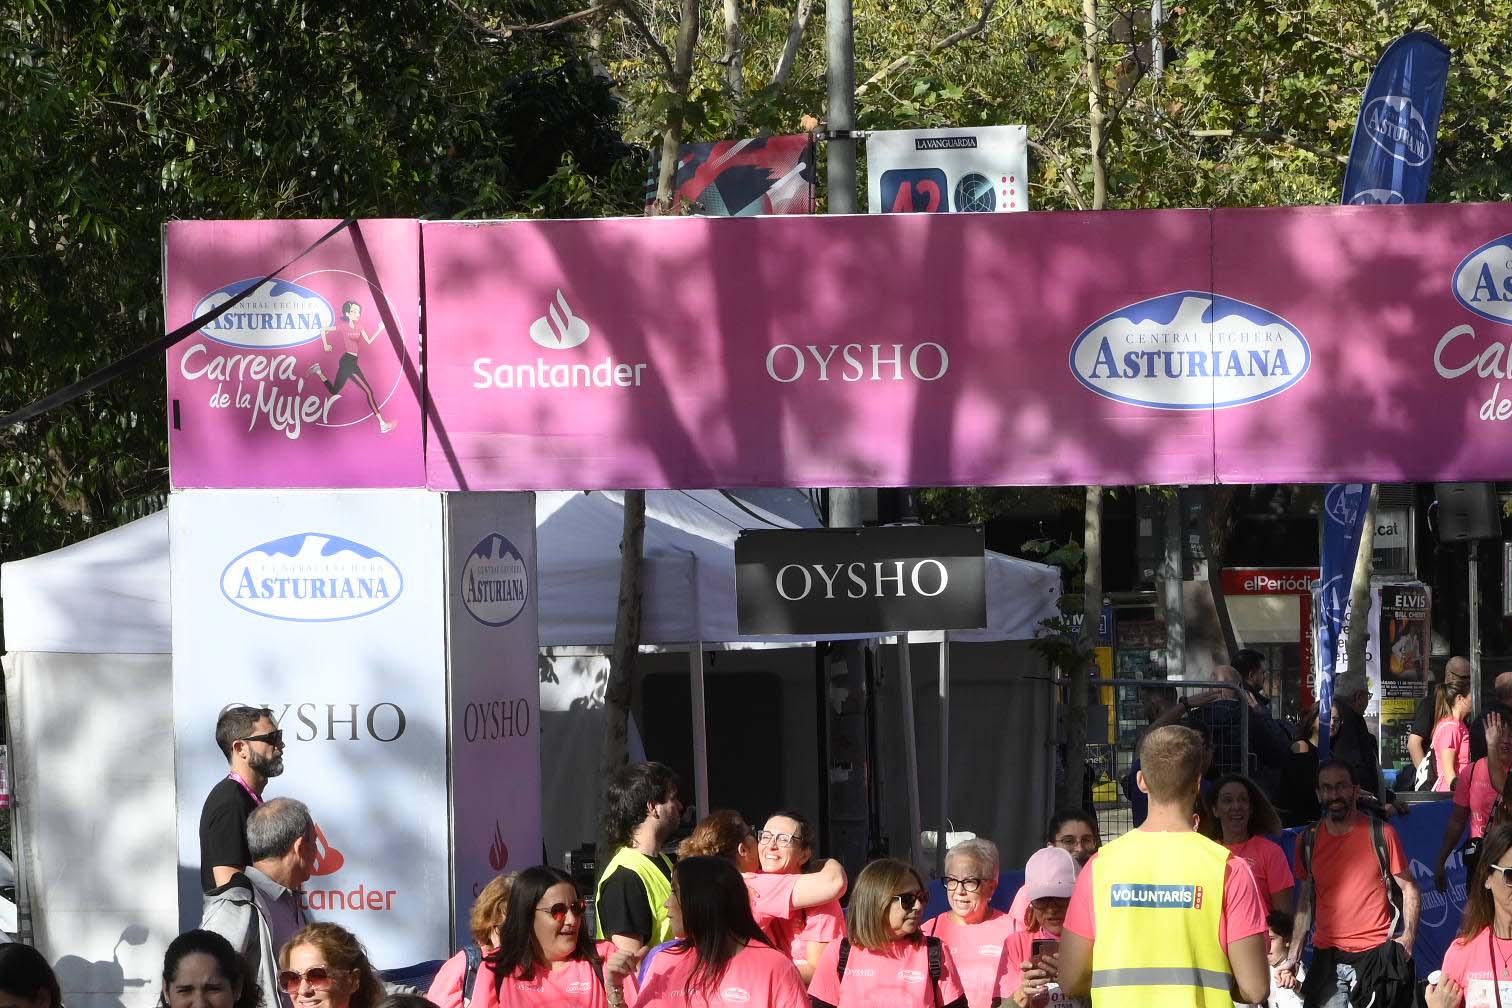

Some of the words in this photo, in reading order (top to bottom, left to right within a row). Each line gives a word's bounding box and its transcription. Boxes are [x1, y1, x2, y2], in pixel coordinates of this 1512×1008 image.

[204, 304, 323, 330] ASTURIANA
[1125, 332, 1198, 344] CENTRAL
[180, 344, 298, 382] Carrera
[473, 357, 647, 389] Santander
[766, 341, 949, 383] OYSHO
[1088, 336, 1292, 379] ASTURIANA
[209, 384, 230, 409] de
[234, 383, 251, 409] la
[248, 377, 342, 440] Mujer
[234, 567, 390, 599] ASTURIANA
[467, 570, 525, 603] ASTURIANA
[775, 558, 949, 601] OYSHO
[1395, 594, 1425, 608] ELVIS
[463, 697, 530, 744] OYSHO
[299, 884, 398, 911] tander
[1113, 888, 1192, 903] VOLUNTARIS
